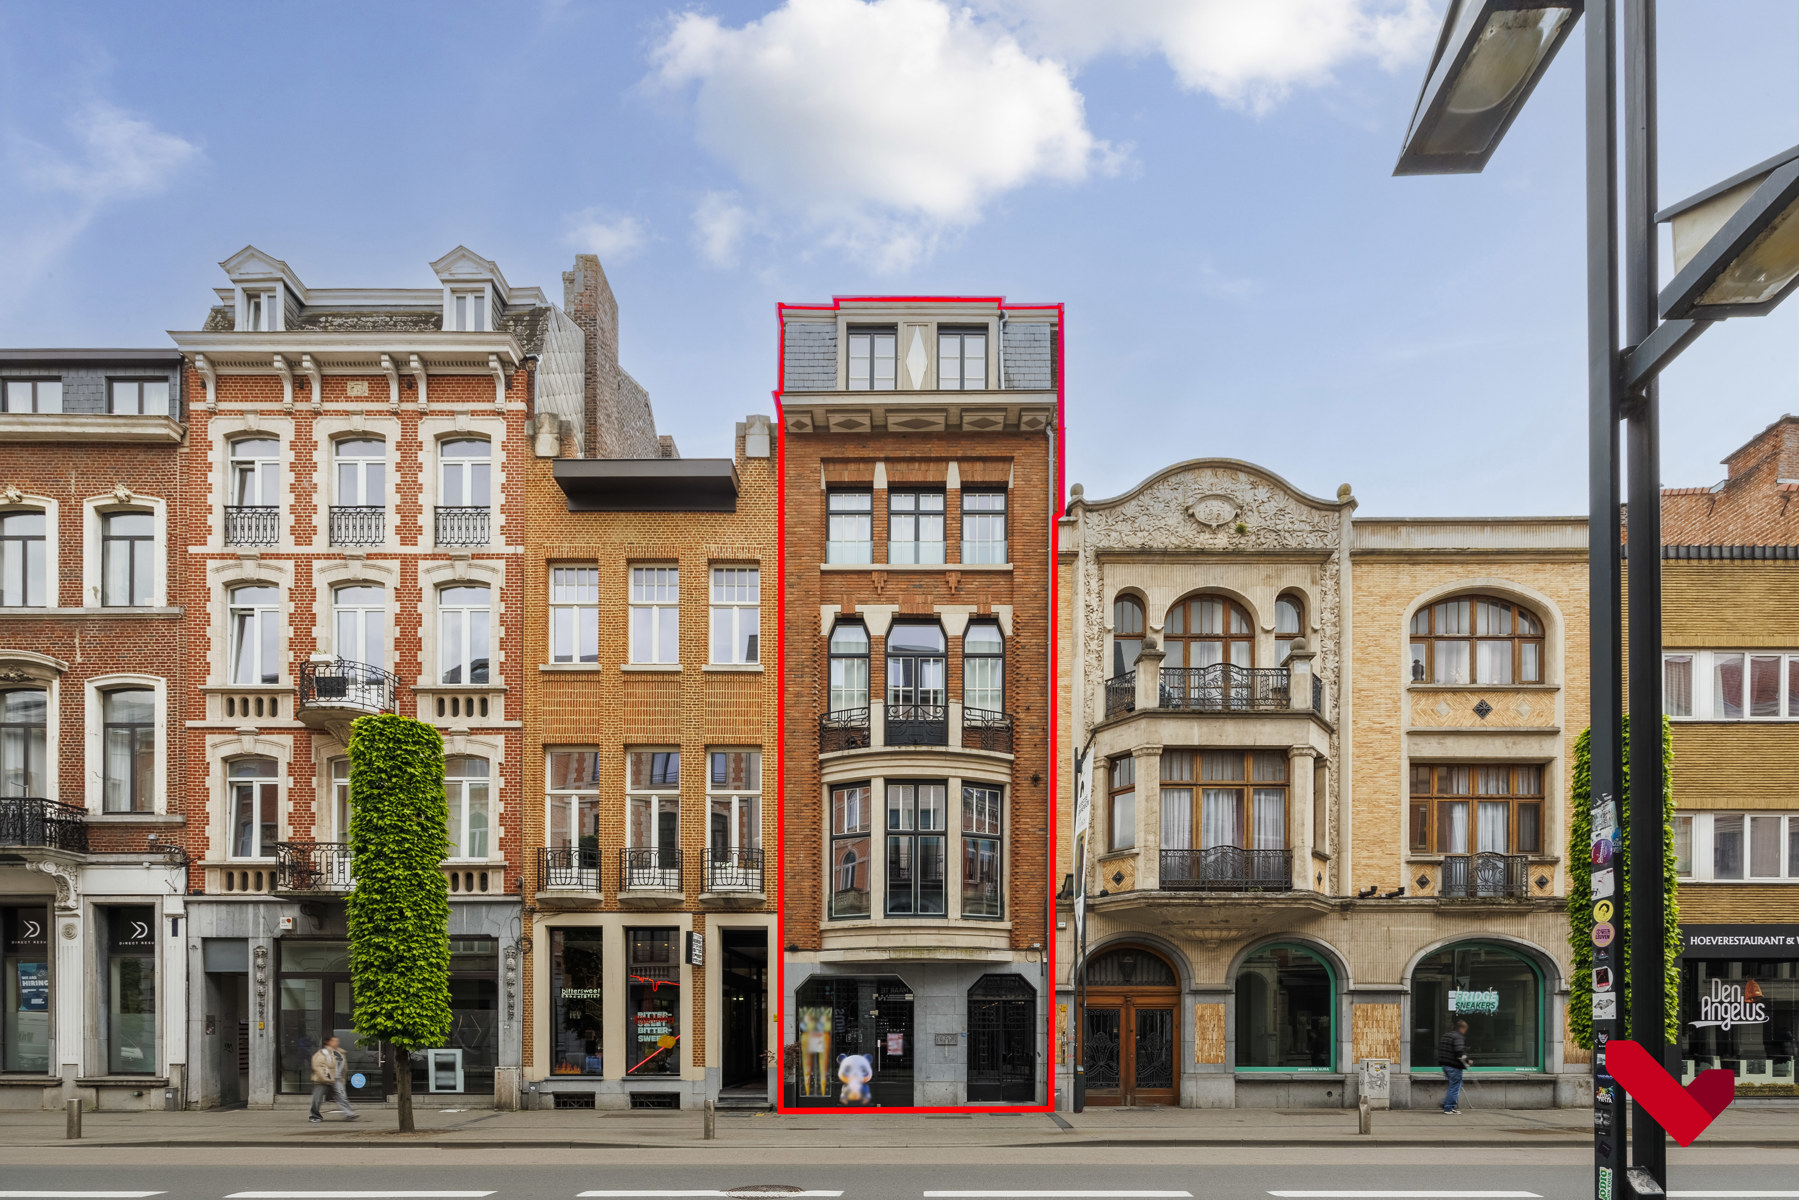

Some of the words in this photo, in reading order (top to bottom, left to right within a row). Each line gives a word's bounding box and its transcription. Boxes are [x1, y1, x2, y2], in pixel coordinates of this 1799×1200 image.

[1690, 936, 1785, 946] HOEVERESTAURANT
[1786, 936, 1795, 945] &
[1455, 991, 1498, 1001] FRIDGE
[1711, 978, 1741, 1002] Den
[1701, 996, 1766, 1031] Angelus
